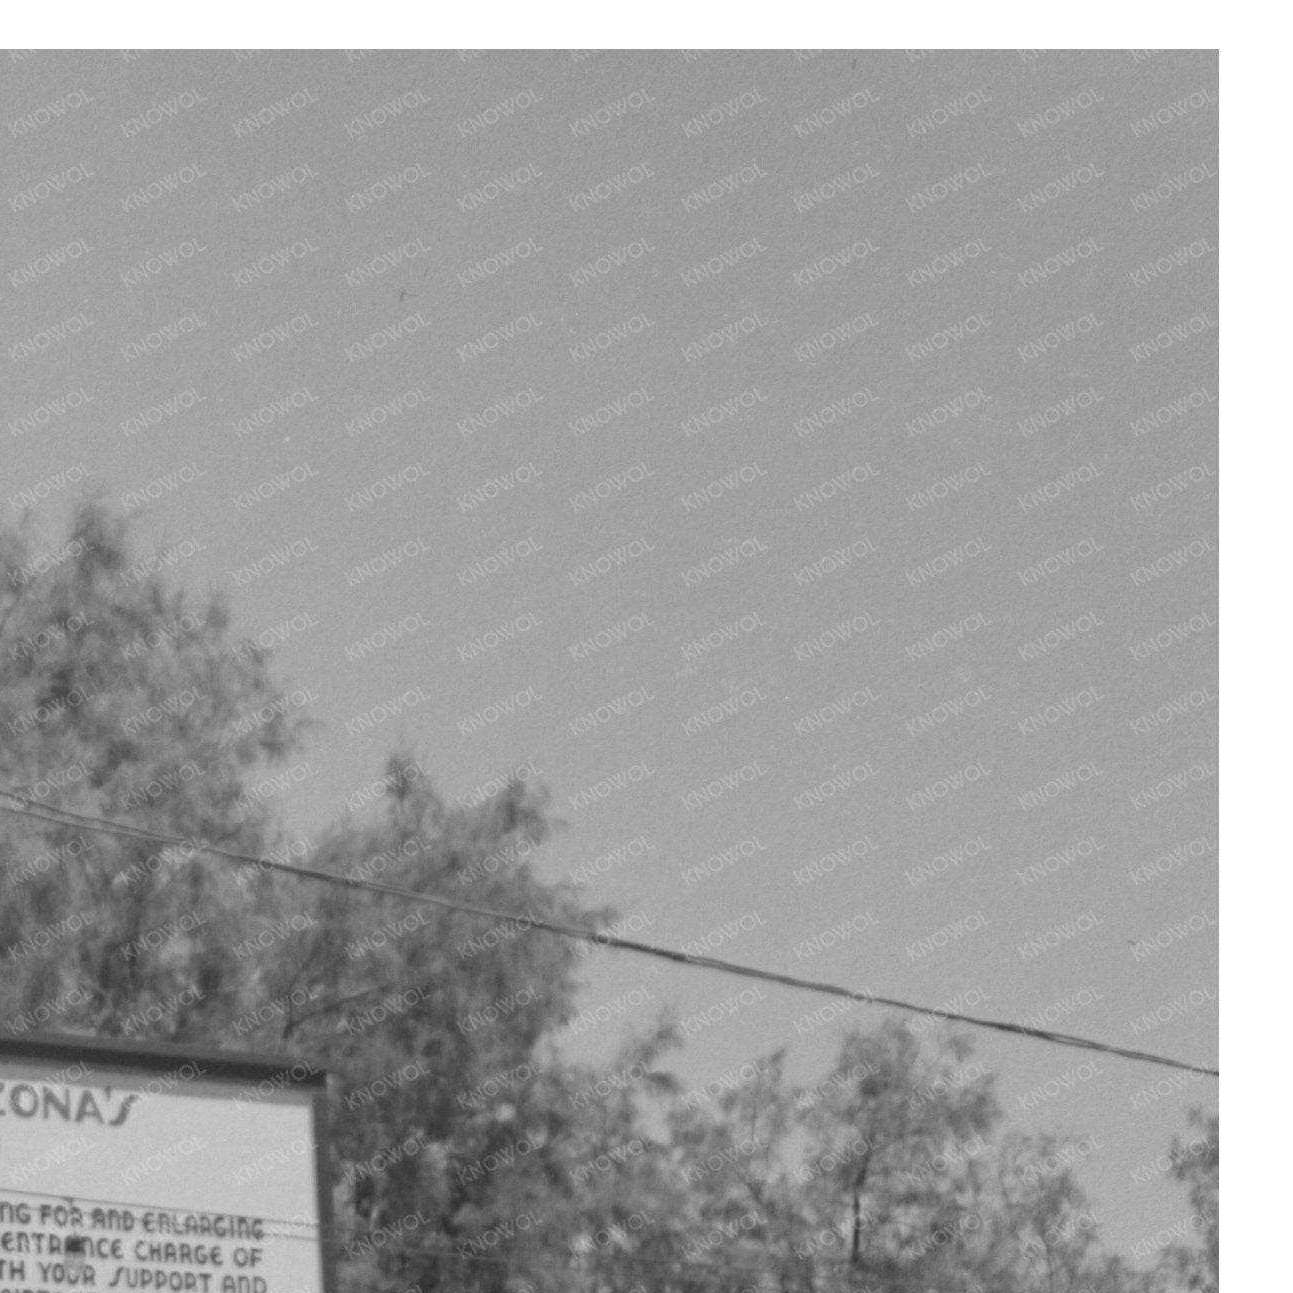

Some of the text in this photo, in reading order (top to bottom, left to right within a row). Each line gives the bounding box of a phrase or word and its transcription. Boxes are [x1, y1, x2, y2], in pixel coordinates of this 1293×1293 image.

[35, 1203, 84, 1229] FOR
[87, 1207, 138, 1233] AND
[142, 1210, 267, 1242] ENLARGING
[0, 1231, 124, 1262] ENTRNCE
[133, 1239, 224, 1268] CHARGE
[232, 1246, 264, 1269] OF
[37, 1261, 96, 1287] YOUR
[107, 1265, 213, 1293] SUPPORT
